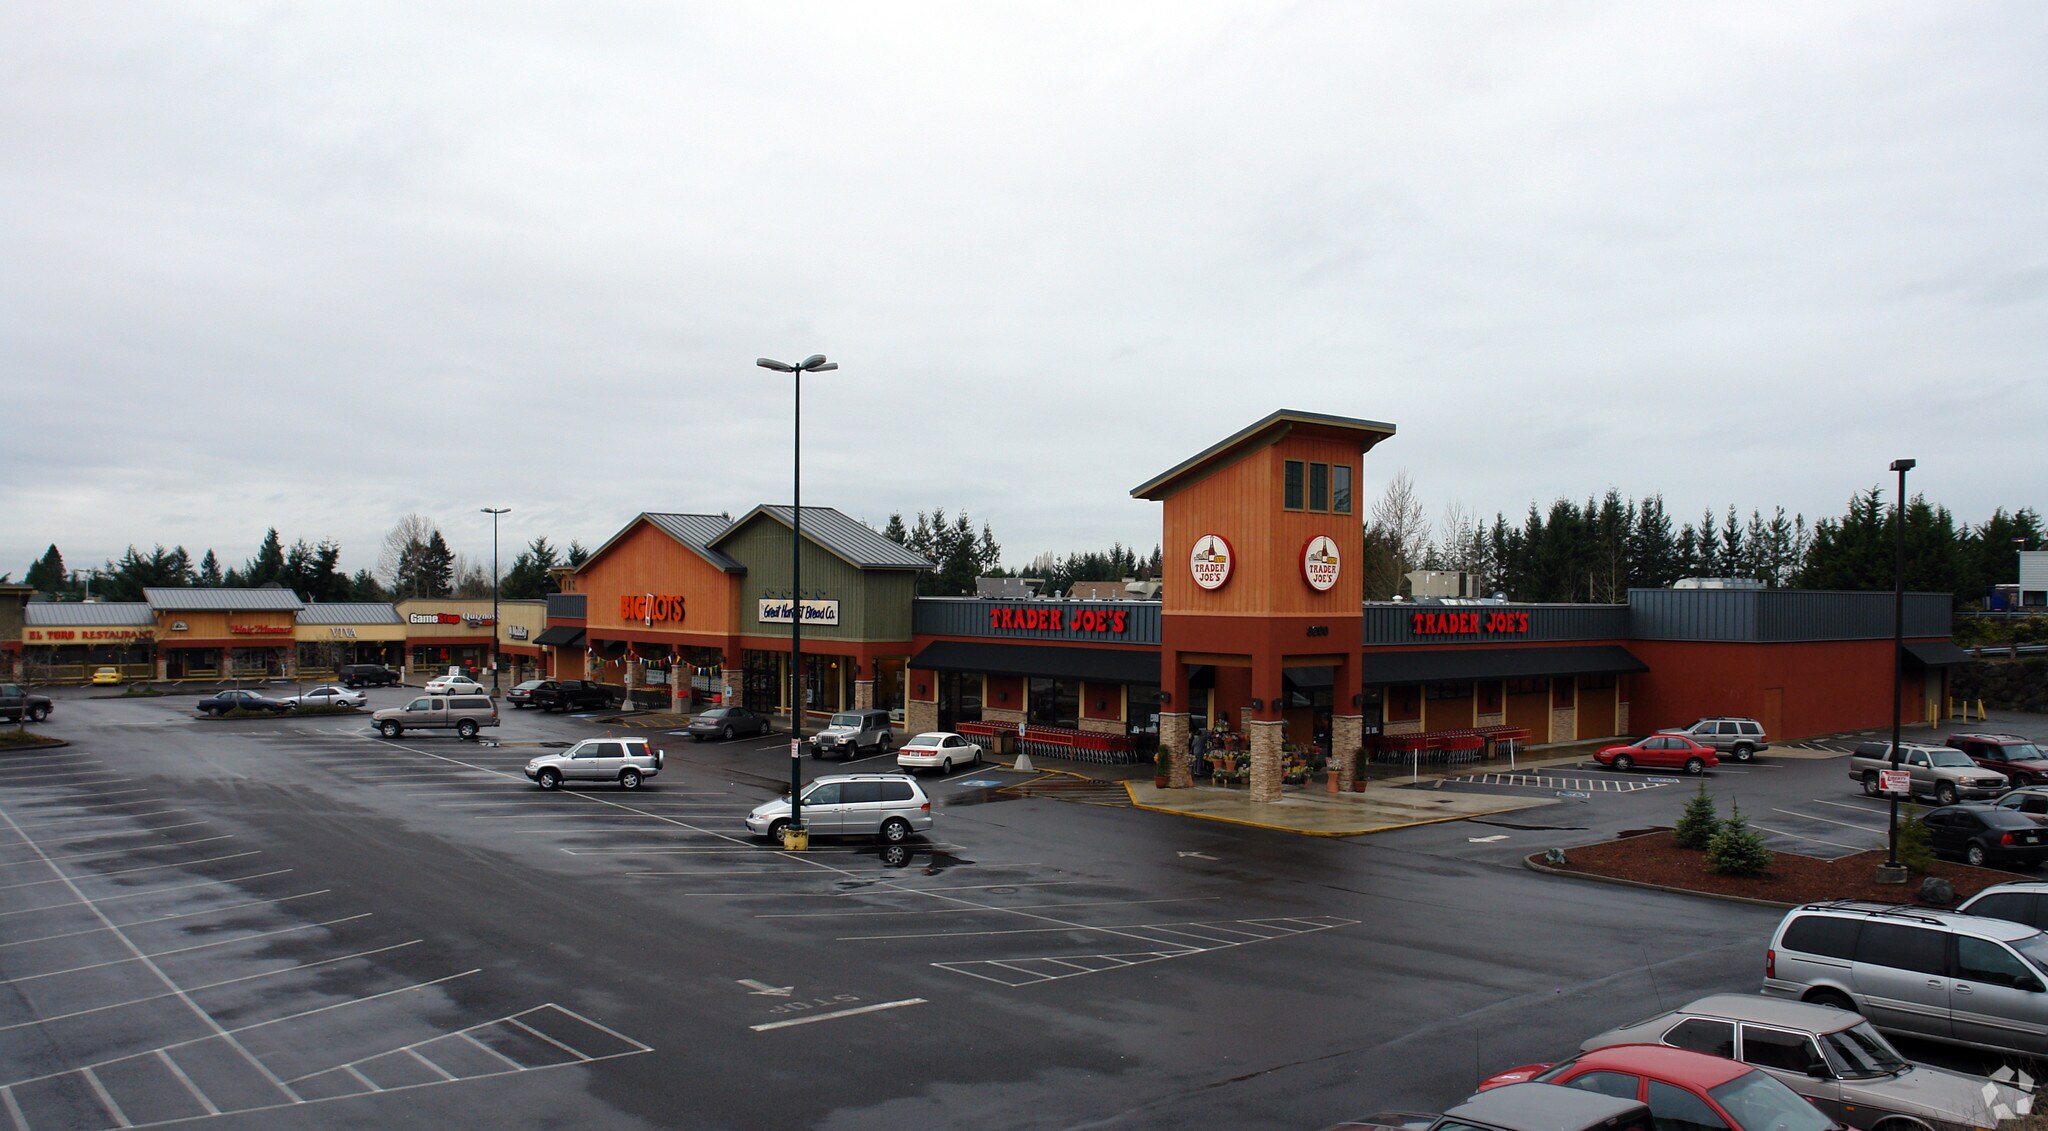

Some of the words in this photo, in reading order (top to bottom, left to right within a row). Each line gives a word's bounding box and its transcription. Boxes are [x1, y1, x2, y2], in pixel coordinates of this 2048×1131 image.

[1195, 564, 1225, 573] TRADER
[1310, 565, 1336, 574] TRADER
[1199, 573, 1221, 582] JOE'S
[1313, 574, 1333, 583] JOE'S
[462, 612, 496, 621] Quiznos
[763, 604, 780, 618] Great
[805, 605, 825, 619] Bread
[409, 613, 460, 625] GameStop
[990, 608, 1063, 630] TRADER
[1070, 610, 1127, 633] JOE'S
[1413, 613, 1480, 634] TRADER
[1486, 612, 1529, 633] JOE'S
[29, 631, 42, 640] EL
[47, 631, 75, 640] TORO
[82, 630, 154, 640] RESTAURANT
[330, 627, 357, 638] VIVA
[769, 994, 860, 1013] STOP
